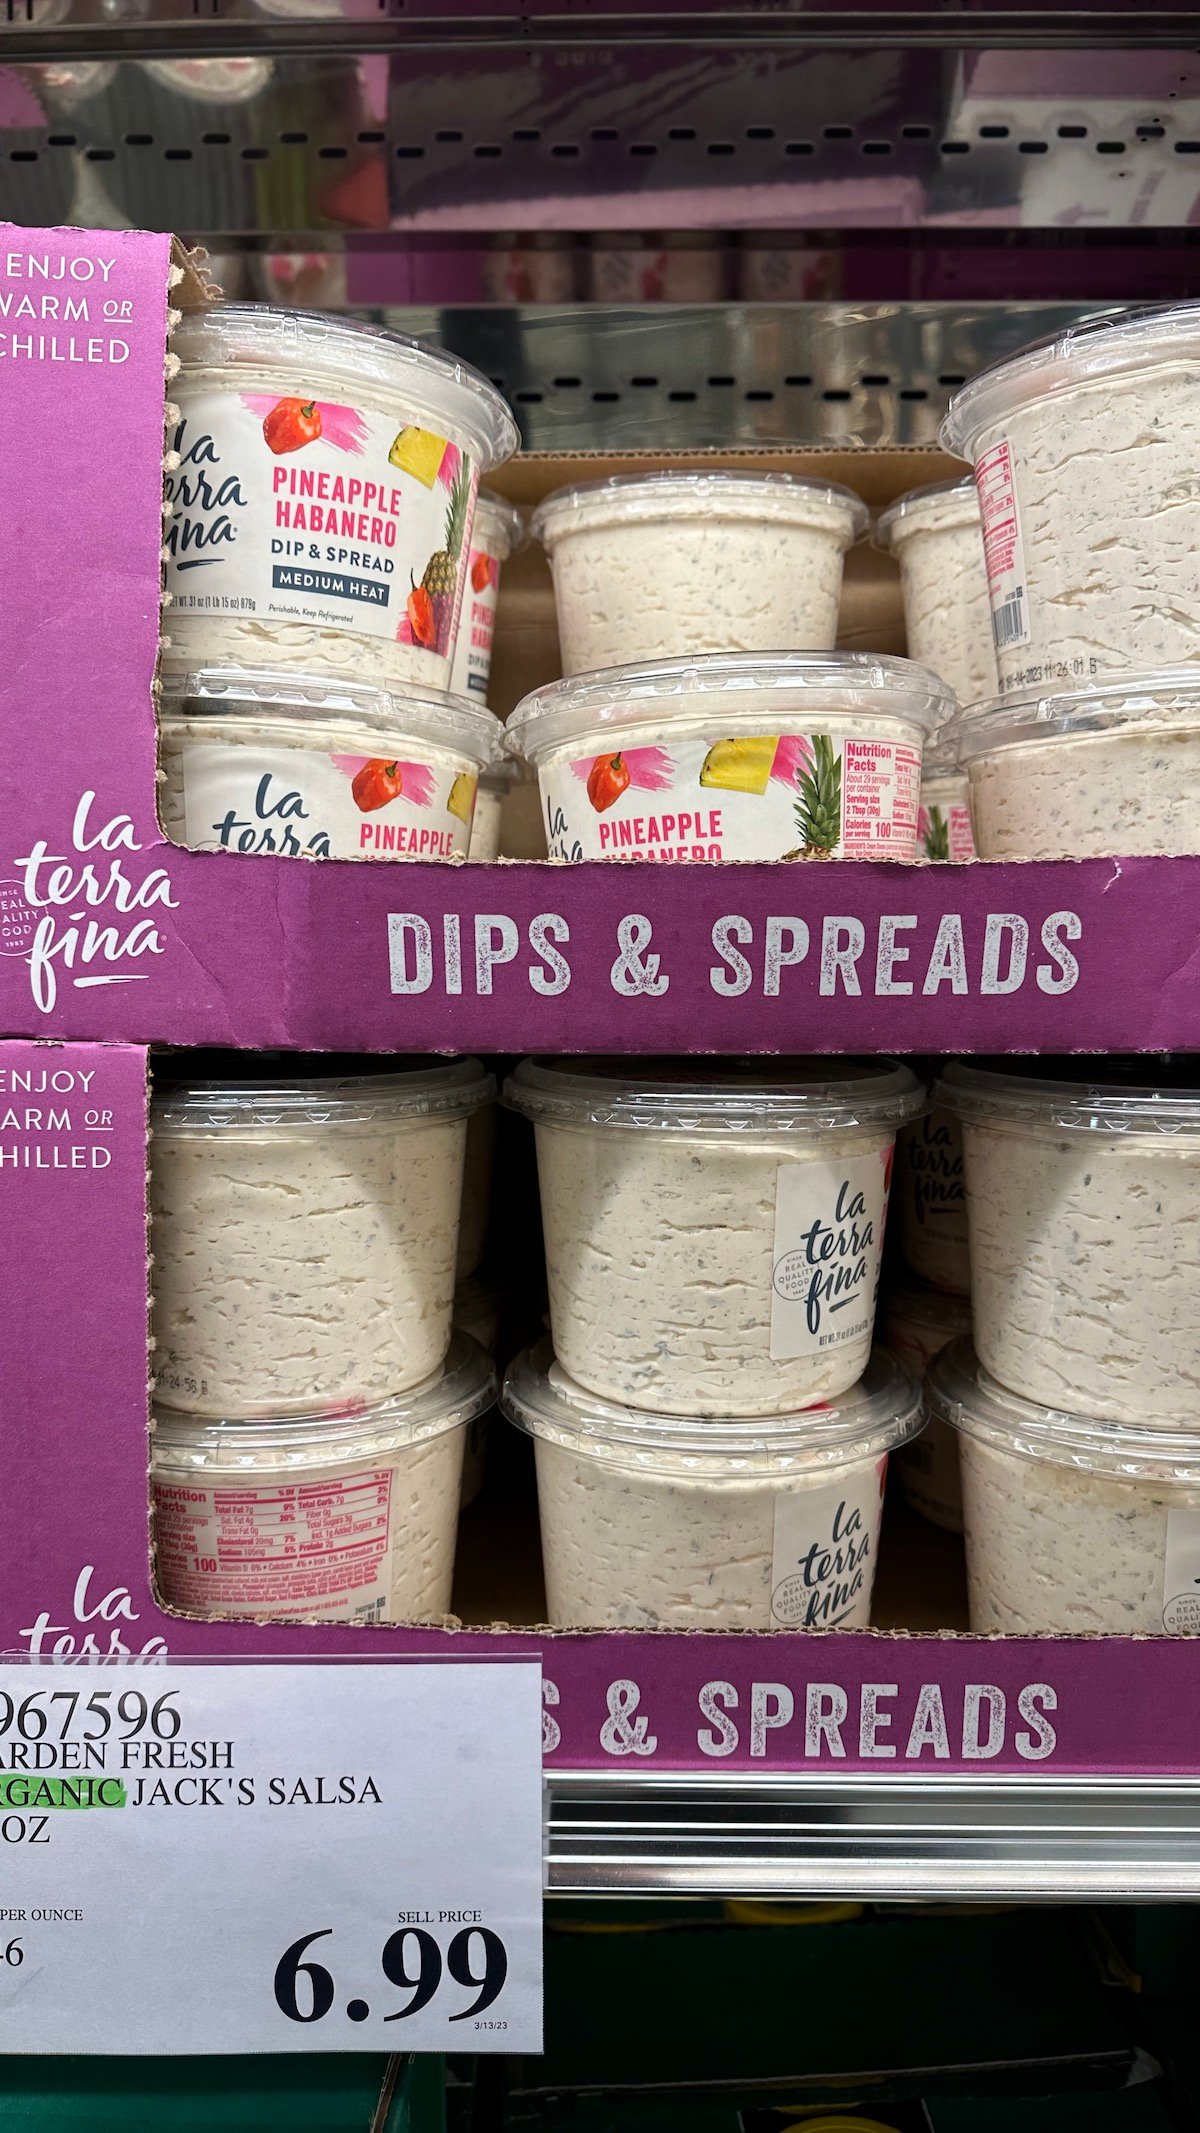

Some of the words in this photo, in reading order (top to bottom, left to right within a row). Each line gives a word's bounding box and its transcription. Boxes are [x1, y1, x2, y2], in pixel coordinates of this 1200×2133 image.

[6, 252, 117, 282] ENJOY
[102, 299, 134, 318] OR
[273, 466, 402, 516] PINEAPPLE
[275, 500, 397, 548] HABANERO
[163, 513, 232, 557] ina
[271, 538, 304, 556] DIP
[308, 543, 321, 559] &
[326, 546, 395, 574] SPREAD
[279, 571, 345, 592] MEDIUM
[350, 581, 385, 600] HEAT
[190, 596, 196, 607] 31
[222, 597, 229, 609] 15
[240, 598, 256, 611] 879g
[269, 603, 301, 615] Perishable,
[302, 608, 317, 618] Keep
[318, 610, 354, 623] Refrigerated
[847, 742, 892, 759] Nutrition
[847, 757, 877, 772] Facts
[846, 774, 863, 783] About
[255, 773, 309, 819] la
[846, 784, 855, 793] per
[856, 784, 880, 793] container
[846, 794, 868, 805] Serving
[869, 795, 880, 804] size
[547, 795, 568, 839] la
[846, 805, 851, 814] 2
[851, 805, 866, 816] Tbsp
[866, 805, 881, 817] (30g)
[72, 790, 143, 852] la
[598, 810, 723, 850] PINEAPPLE
[845, 819, 871, 829] Calories
[875, 821, 891, 838] 100
[212, 810, 332, 858] terra
[359, 823, 454, 857] PINEAPPLE
[14, 840, 180, 913] terra
[25, 911, 165, 1014] fina
[386, 912, 572, 996] DIPS
[609, 912, 670, 998] &
[708, 909, 1083, 998] SPREADS
[84, 1109, 114, 1125] OR
[835, 1180, 867, 1223] la
[800, 1219, 874, 1265] terra
[778, 1267, 815, 1285] QUALITY
[784, 1261, 806, 1273] REAL
[785, 1277, 810, 1291] FOOD
[803, 1255, 869, 1335] fina
[154, 1486, 207, 1503] Nutrition
[285, 1487, 295, 1496] DV
[156, 1498, 187, 1513] Facts
[214, 1505, 232, 1514] Total
[232, 1506, 244, 1514] Fat
[245, 1506, 254, 1515] 7g
[298, 1500, 316, 1509] Total
[316, 1498, 335, 1507] Carb.
[336, 1496, 345, 1505] 7g
[182, 1515, 209, 1527] servings
[234, 1516, 245, 1525] Fat
[246, 1516, 254, 1526] 4g
[280, 1514, 296, 1522] 20%
[306, 1509, 322, 1519] Fiber
[322, 1509, 332, 1519] 0g
[832, 1500, 862, 1543] la
[222, 1526, 239, 1535] Trans
[239, 1526, 249, 1535] Fat
[250, 1526, 259, 1536] 0g
[306, 1520, 322, 1530] Total
[322, 1517, 344, 1527] Sugars
[325, 1529, 334, 1539] 1g
[334, 1525, 352, 1536] Added
[352, 1521, 372, 1532] Sugars
[182, 1532, 196, 1542] size
[217, 1537, 254, 1546] Cholesterol
[255, 1537, 274, 1546] 20mg
[299, 1542, 324, 1552] Protein
[325, 1540, 334, 1549] 2g
[217, 1548, 242, 1556] Sodium
[220, 1563, 242, 1572] Vitamin
[251, 1563, 262, 1572] 0%
[268, 1562, 293, 1571] Calcium
[296, 1560, 307, 1568] 4%
[313, 1557, 326, 1566] Iron
[328, 1554, 339, 1562] 0%
[344, 1546, 374, 1560] Potassium
[376, 1542, 385, 1551] 4%
[797, 1532, 870, 1587] terra
[193, 1557, 217, 1573] 100
[73, 1565, 141, 1623] la
[776, 1588, 813, 1609] QUALITY
[782, 1585, 804, 1599] REAL
[802, 1568, 865, 1627] fina
[783, 1600, 808, 1616] FOOD
[1168, 1613, 1200, 1625] QUALI
[18, 1611, 170, 1666] terra
[599, 1679, 658, 1756] &
[697, 1680, 1059, 1761] SPREADS
[0, 1742, 109, 1770] RDEN
[119, 1741, 236, 1769] FRESH
[0, 1778, 123, 1807] GANIC
[132, 1777, 256, 1807] JACK'S
[268, 1776, 384, 1806] SALSA
[1, 1815, 51, 1844] OZ
[0, 1909, 27, 1921] PER
[31, 1909, 84, 1921] OUNCE
[398, 1910, 434, 1923] SELL
[438, 1910, 483, 1923] PRICE
[273, 1926, 508, 2023] 6.99
[474, 2021, 508, 2030] 3/13/23
